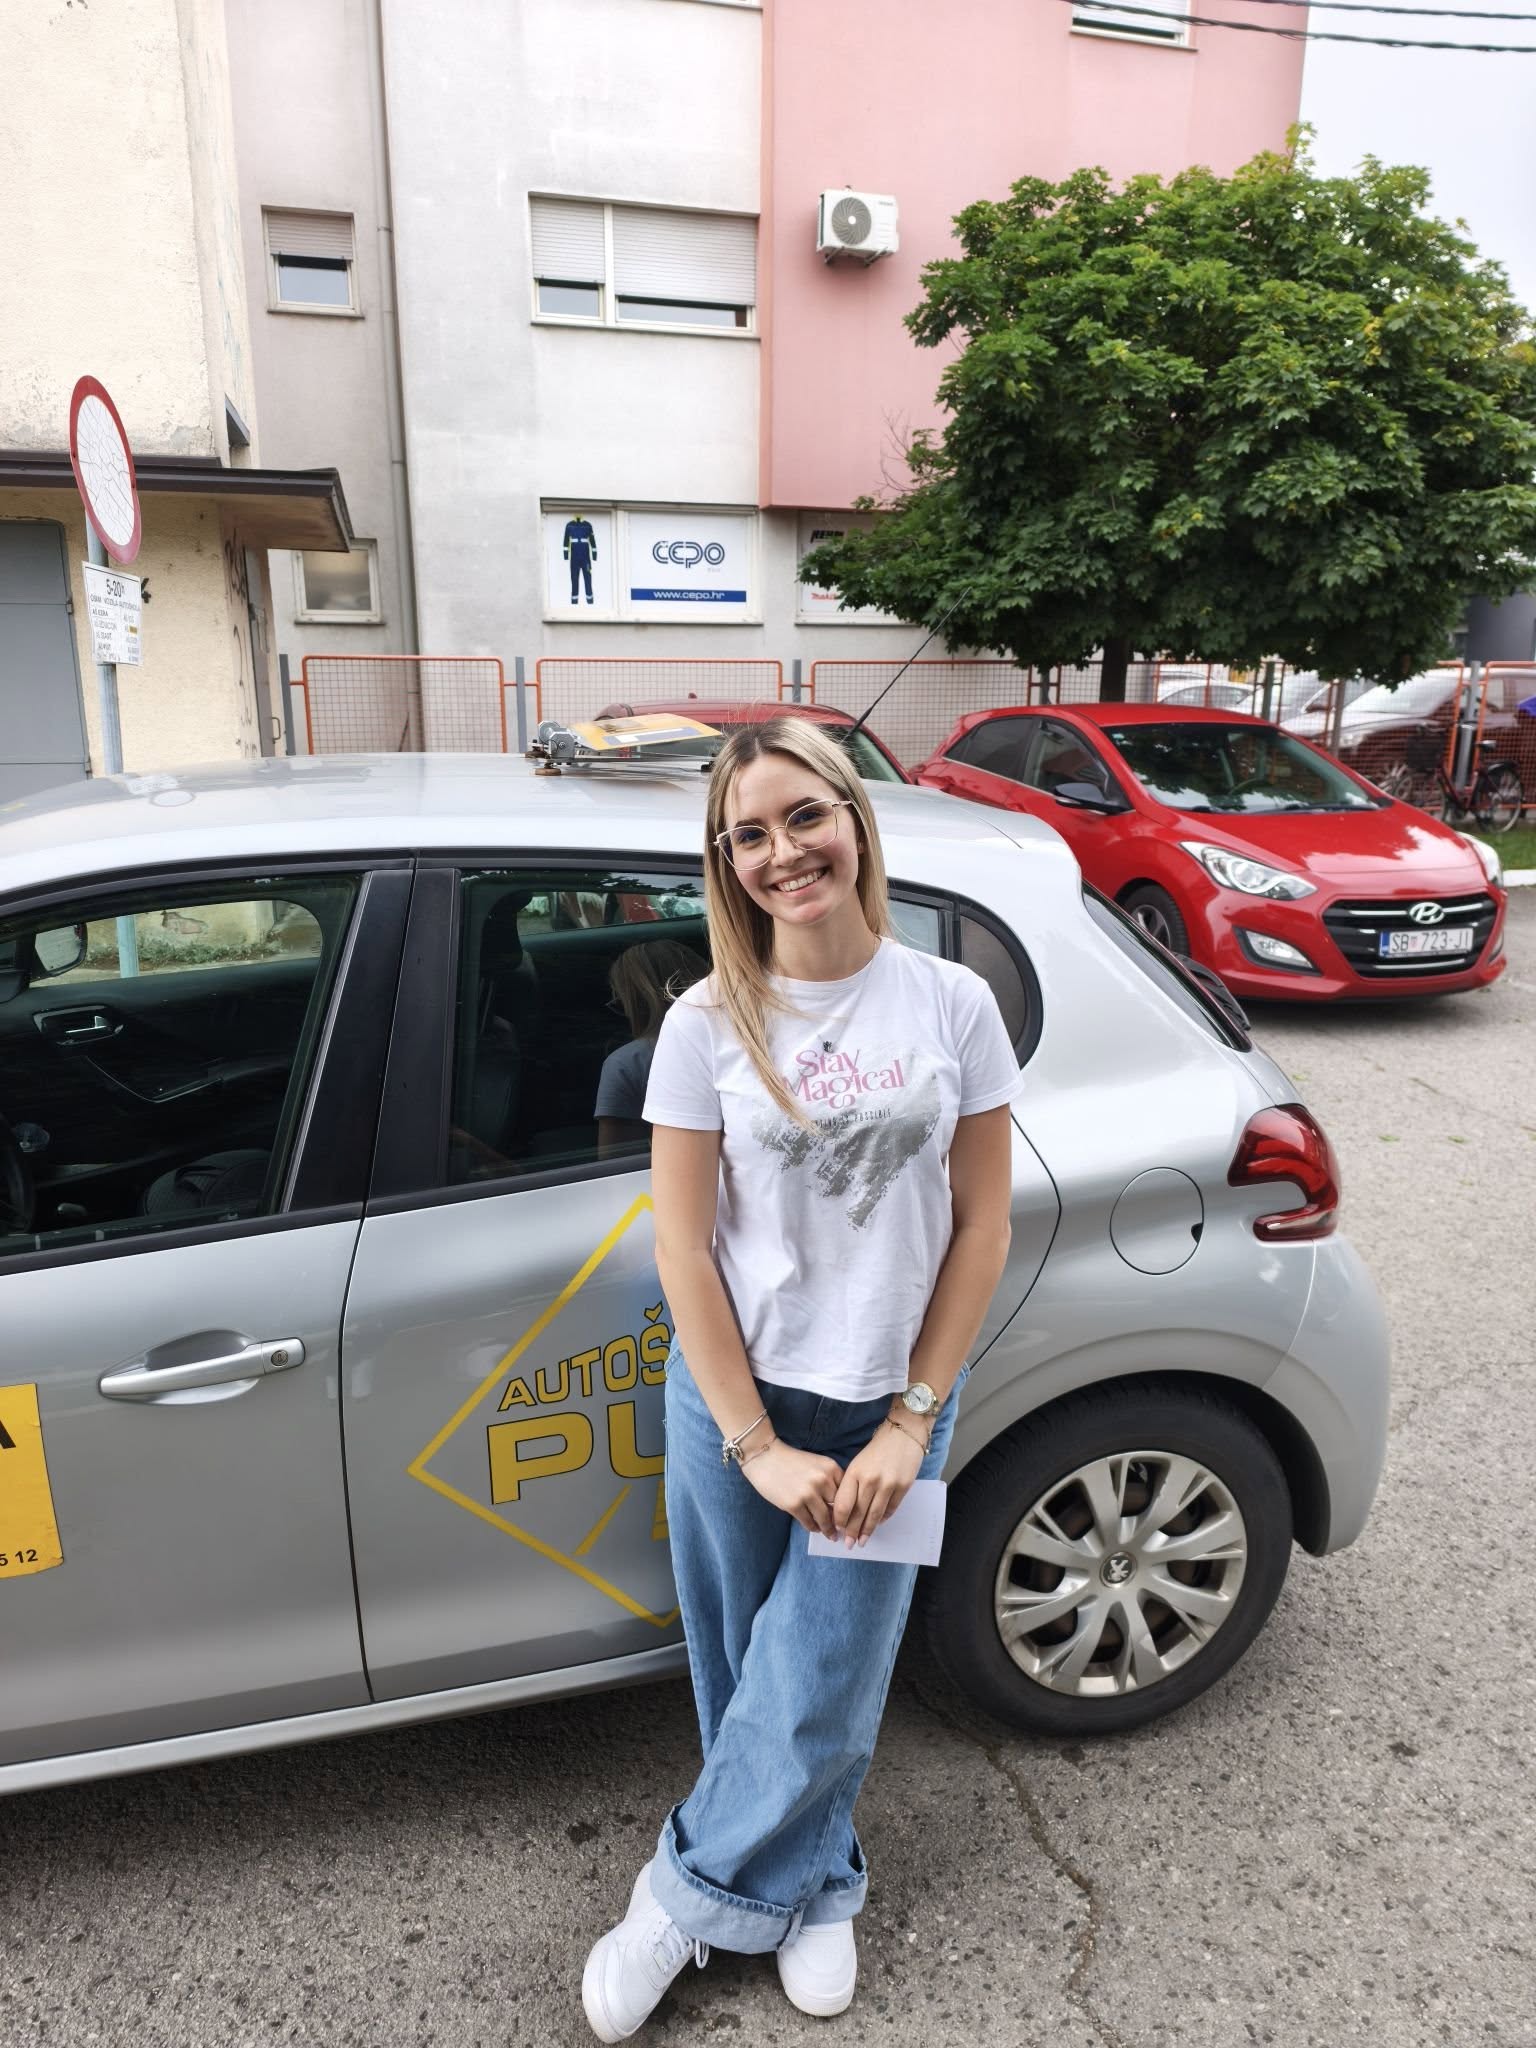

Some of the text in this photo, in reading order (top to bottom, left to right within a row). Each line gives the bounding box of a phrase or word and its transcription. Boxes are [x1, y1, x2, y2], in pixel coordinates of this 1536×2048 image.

[653, 591, 725, 601] www.cepo.hr
[1392, 934, 1409, 952] SB
[795, 1049, 860, 1082] Stay
[783, 1059, 905, 1109] Magical
[854, 1108, 891, 1122] POSSIBLE
[497, 1300, 675, 1412] AUTOŠ
[487, 1401, 667, 1505] PU
[15, 1549, 38, 1563] 12
